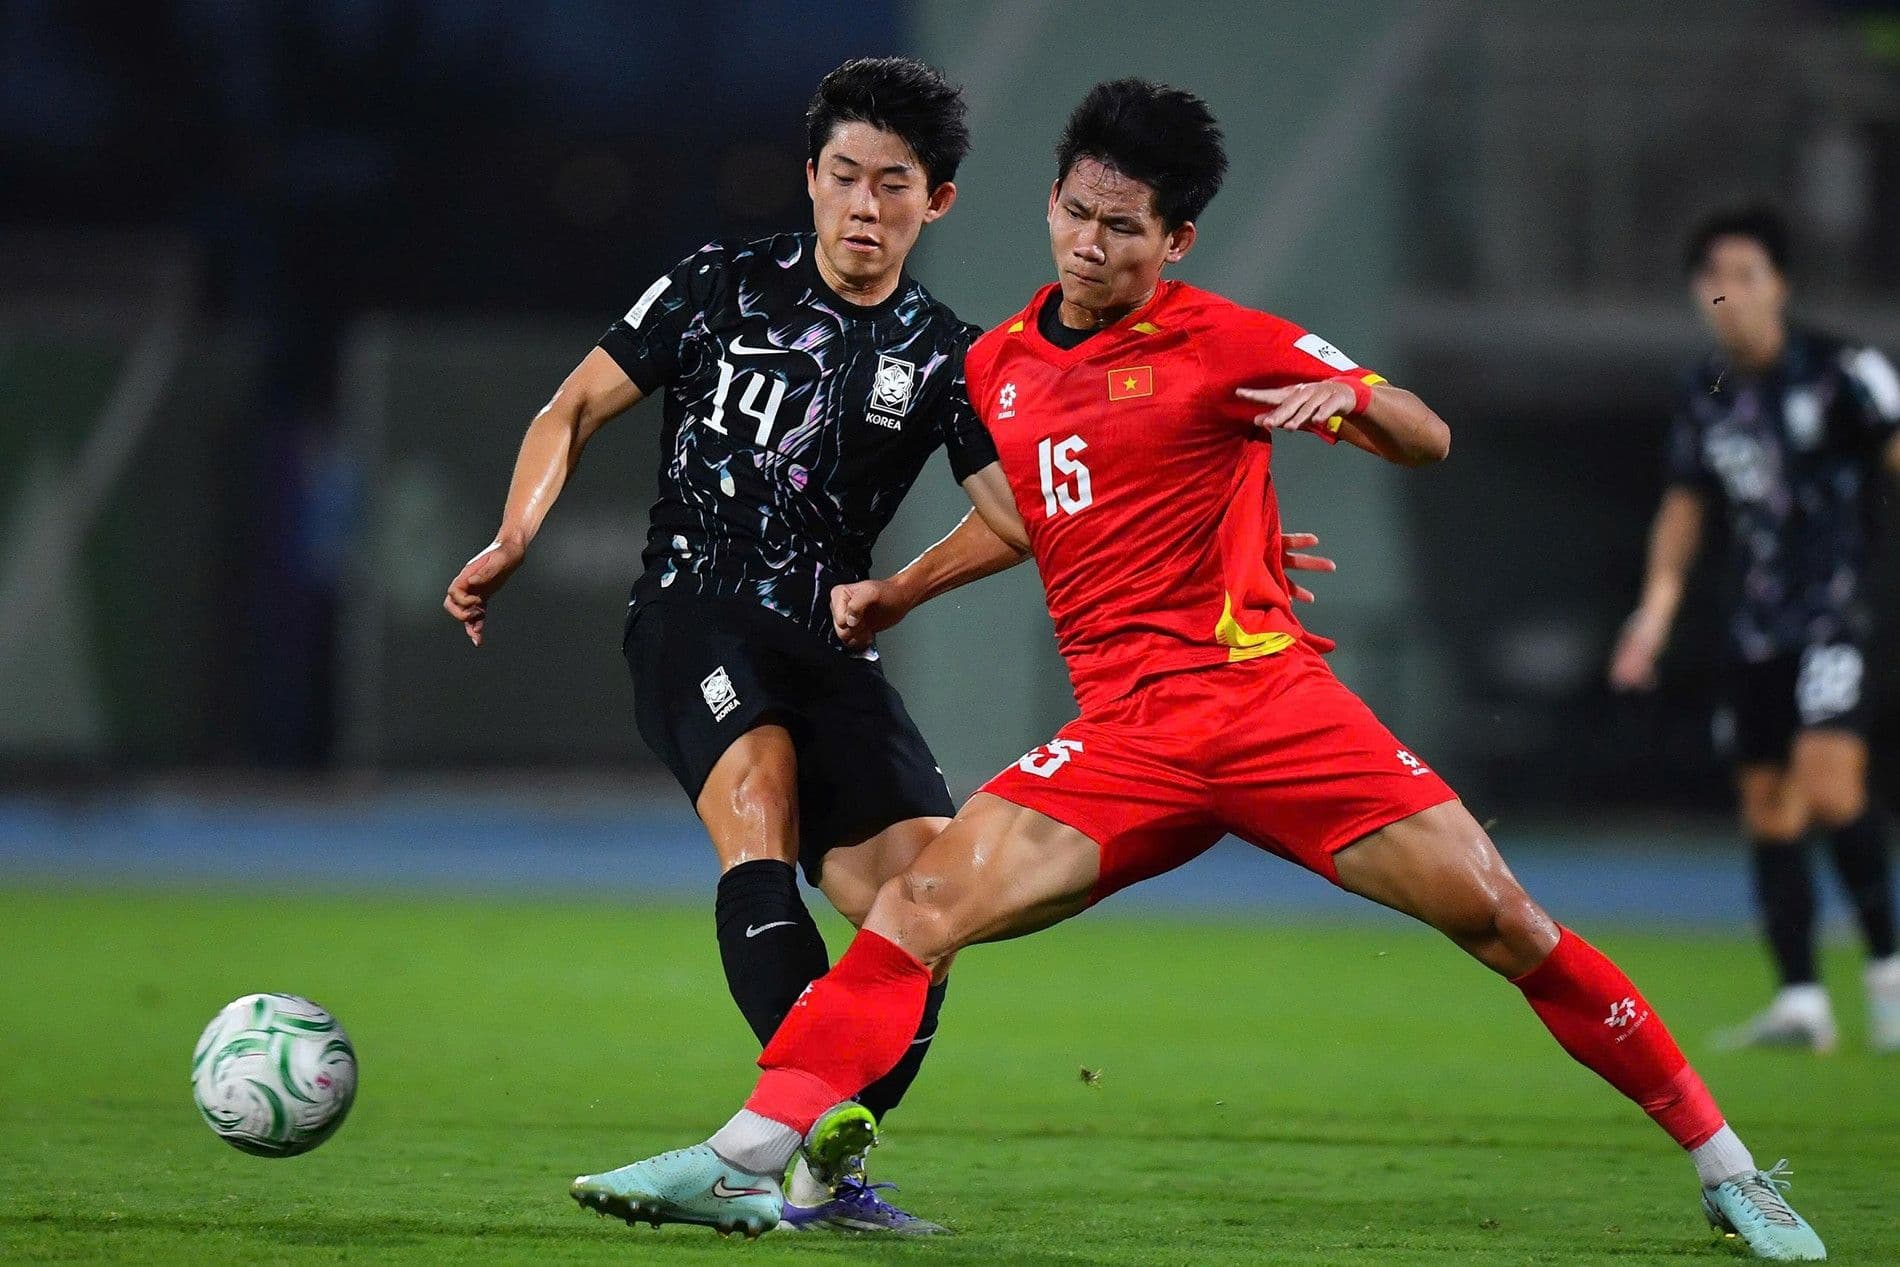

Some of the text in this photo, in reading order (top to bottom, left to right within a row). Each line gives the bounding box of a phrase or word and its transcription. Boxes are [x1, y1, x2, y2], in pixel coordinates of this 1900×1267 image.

[703, 360, 786, 447] 14
[865, 412, 902, 431] KOREA
[1038, 434, 1093, 518] 15
[715, 699, 741, 722] KOREA
